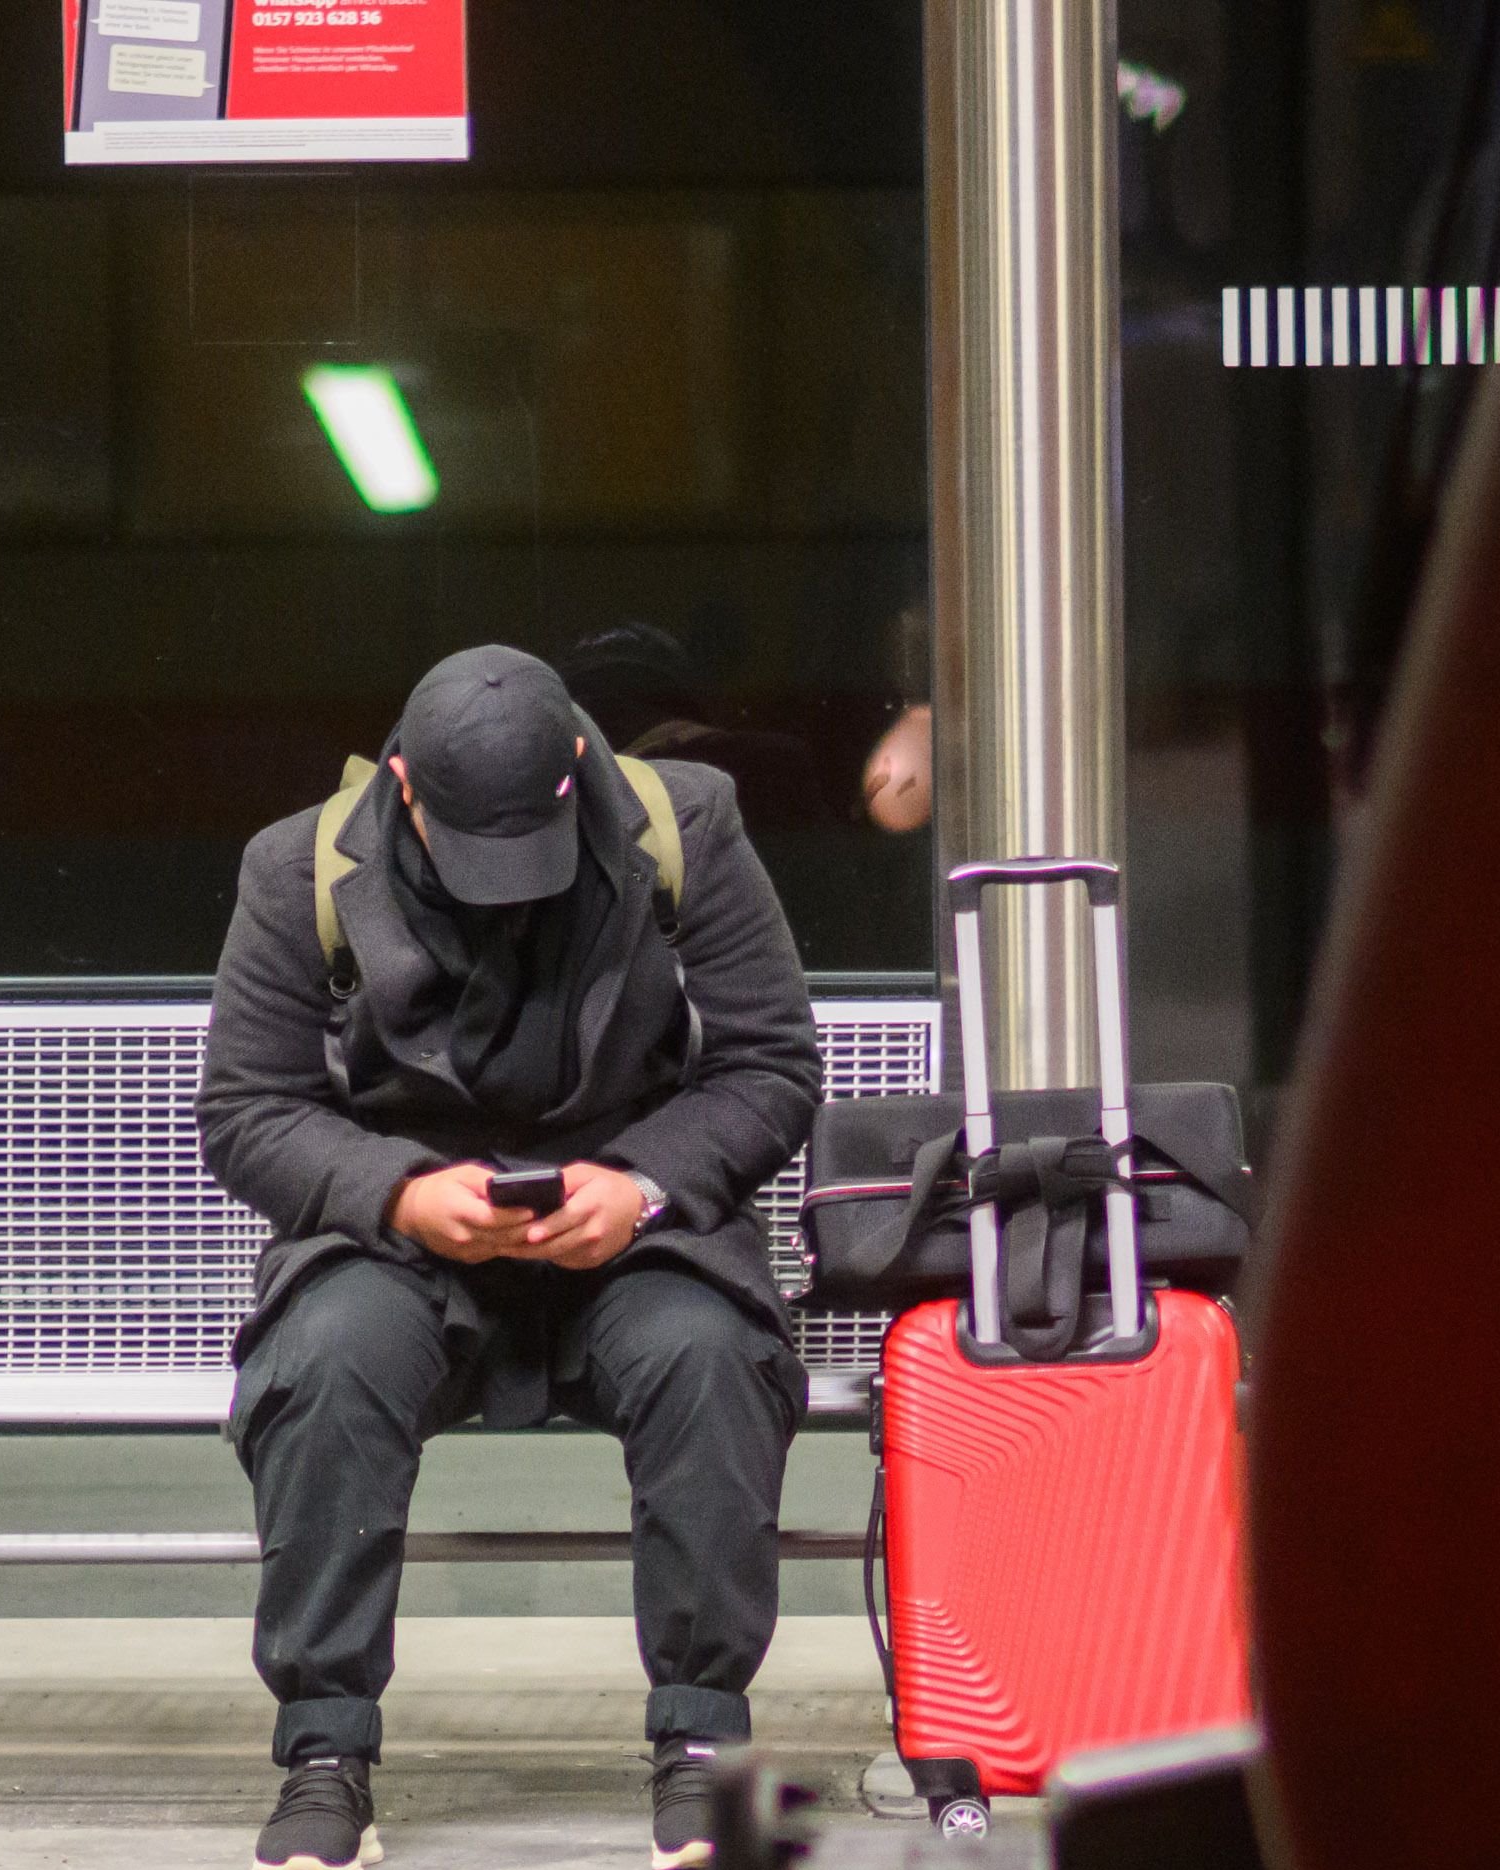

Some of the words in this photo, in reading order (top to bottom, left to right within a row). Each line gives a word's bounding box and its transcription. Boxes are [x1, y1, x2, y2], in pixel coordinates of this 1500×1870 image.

[252, 11, 293, 26] 0157
[294, 11, 324, 26] 923
[327, 10, 358, 25] 628
[360, 10, 382, 25] 36
